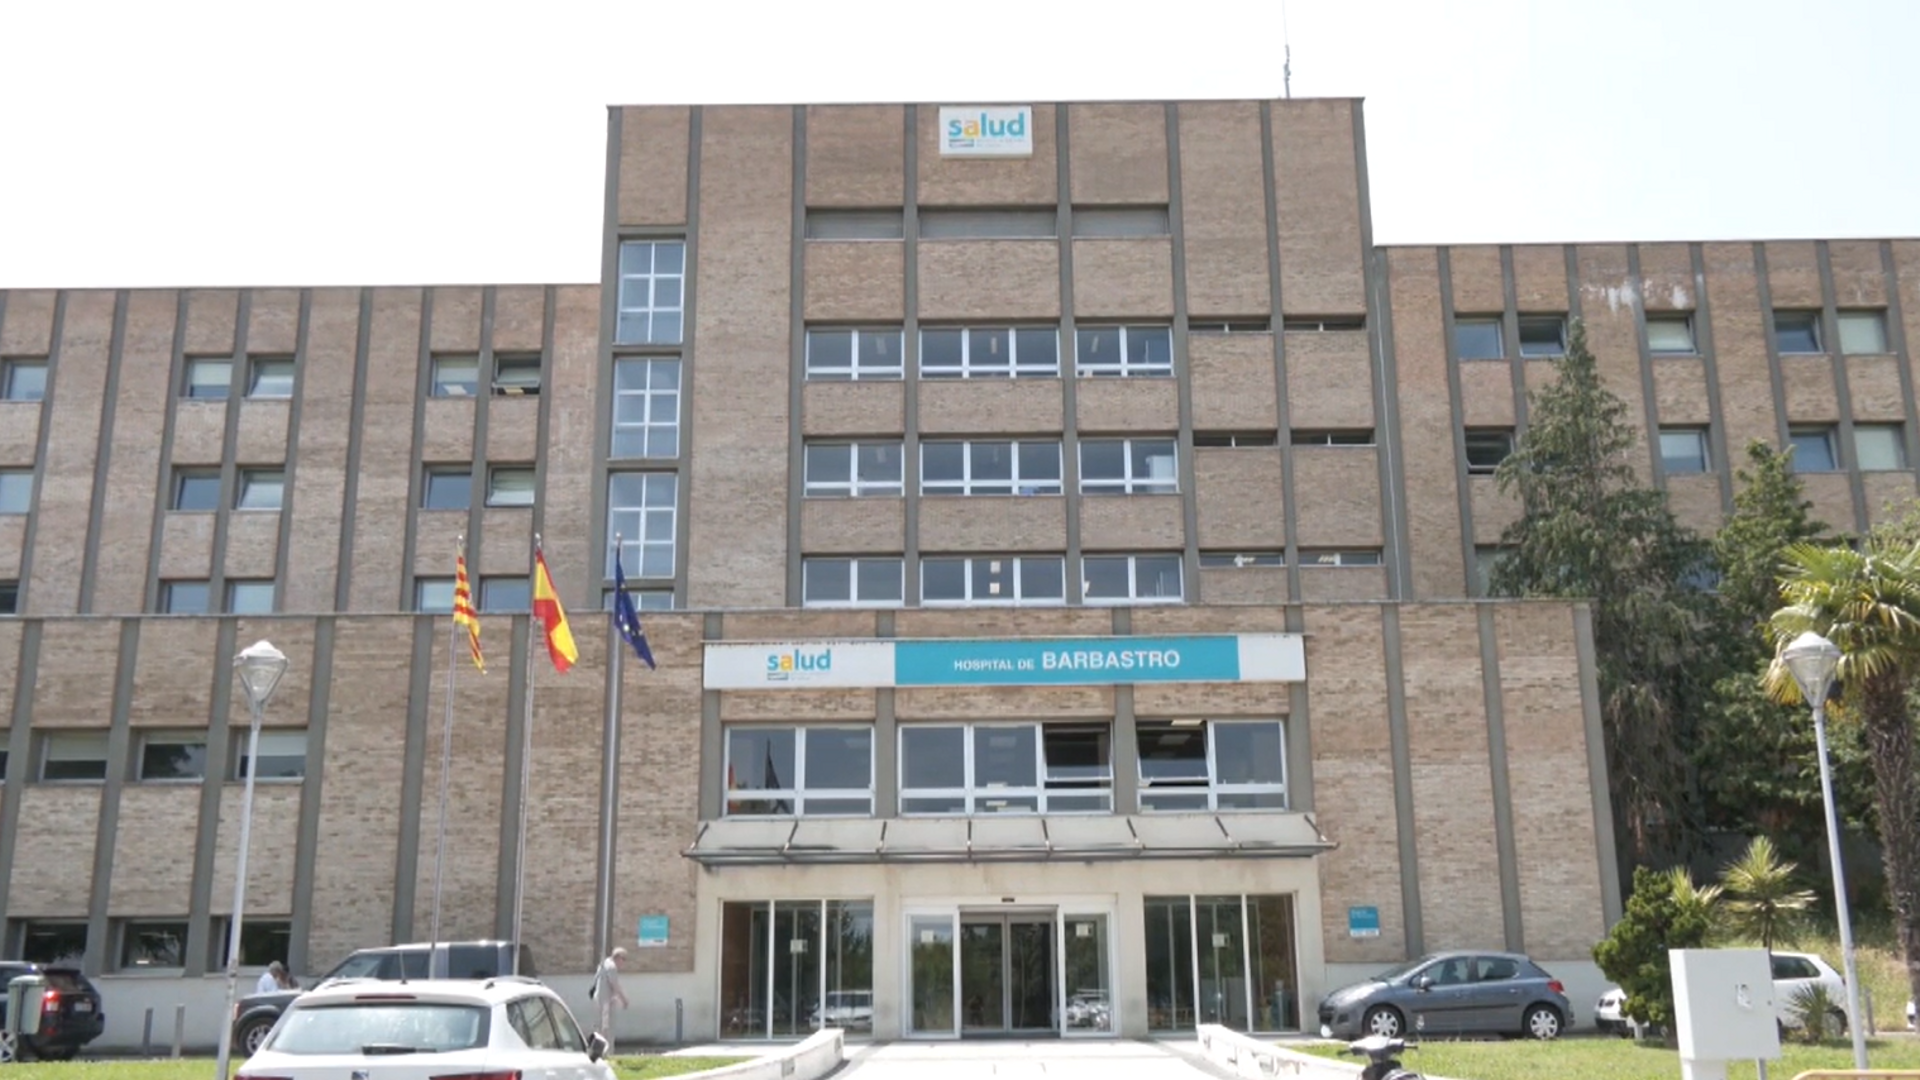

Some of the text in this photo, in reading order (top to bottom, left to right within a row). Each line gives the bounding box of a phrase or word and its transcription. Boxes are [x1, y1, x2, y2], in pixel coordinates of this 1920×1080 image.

[949, 112, 1024, 137] salud
[767, 649, 831, 671] salud
[954, 650, 1181, 671] HOSPITAL DE BARBASTRO
